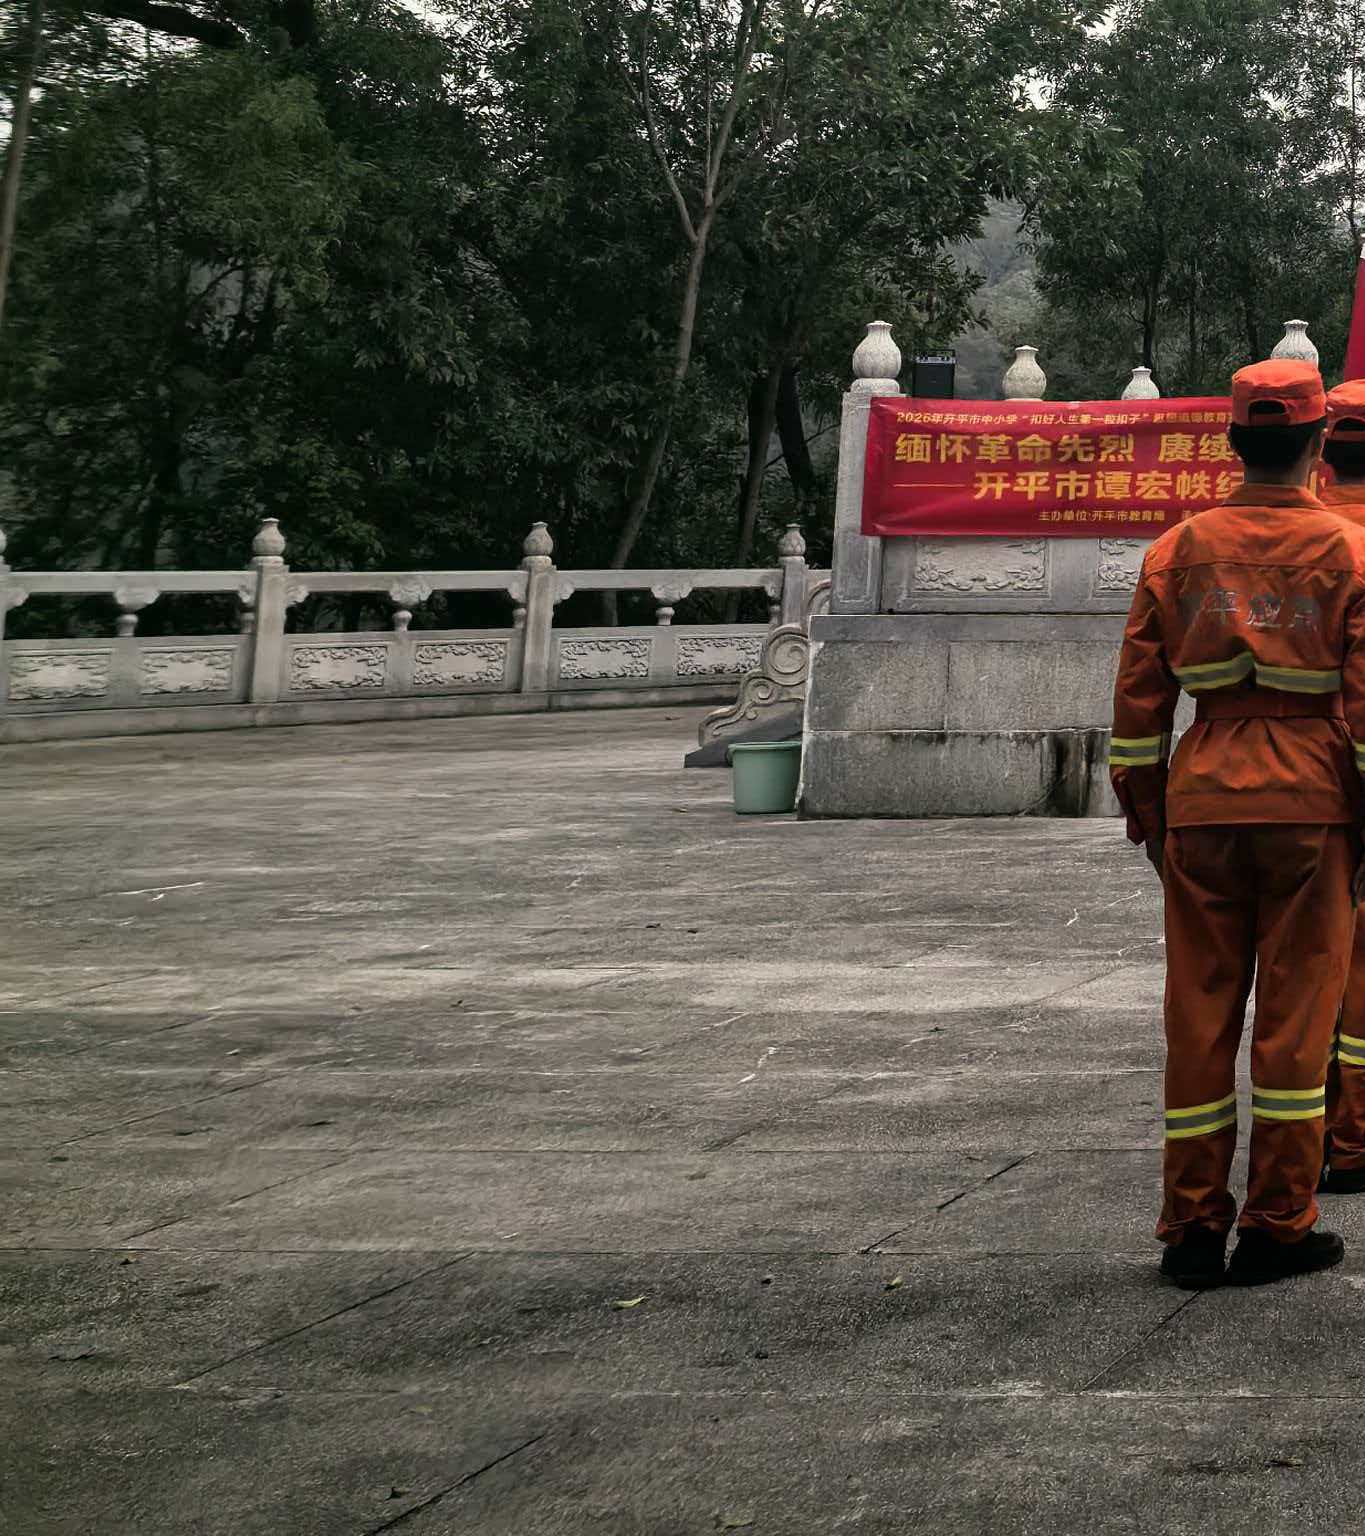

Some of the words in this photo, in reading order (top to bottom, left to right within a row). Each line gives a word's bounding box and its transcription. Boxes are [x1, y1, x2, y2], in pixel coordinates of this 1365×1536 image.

[894, 432, 1135, 464] 缅怀革命先烈
